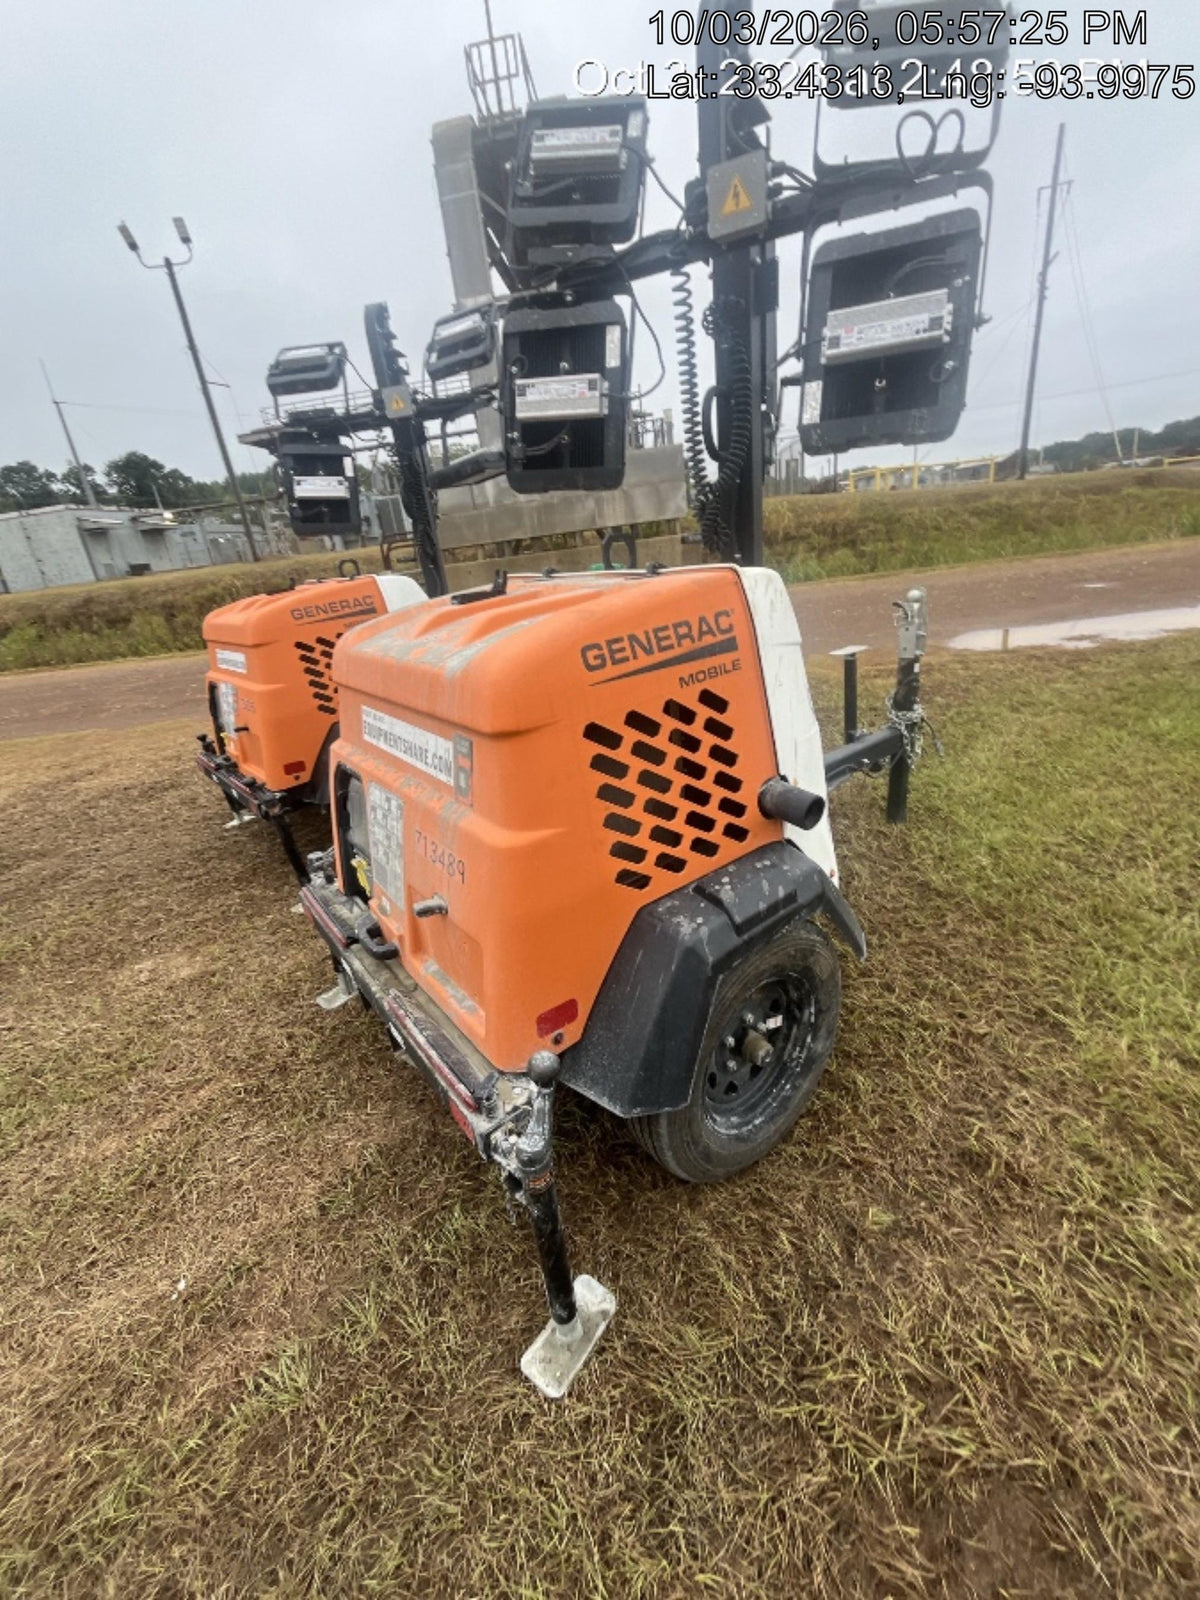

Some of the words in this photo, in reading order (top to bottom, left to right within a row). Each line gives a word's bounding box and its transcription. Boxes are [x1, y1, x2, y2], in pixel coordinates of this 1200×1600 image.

[290, 594, 375, 621] GENERAC
[580, 609, 735, 673] GENERAC
[678, 658, 742, 689] MOBILE
[415, 829, 466, 884] 713489
